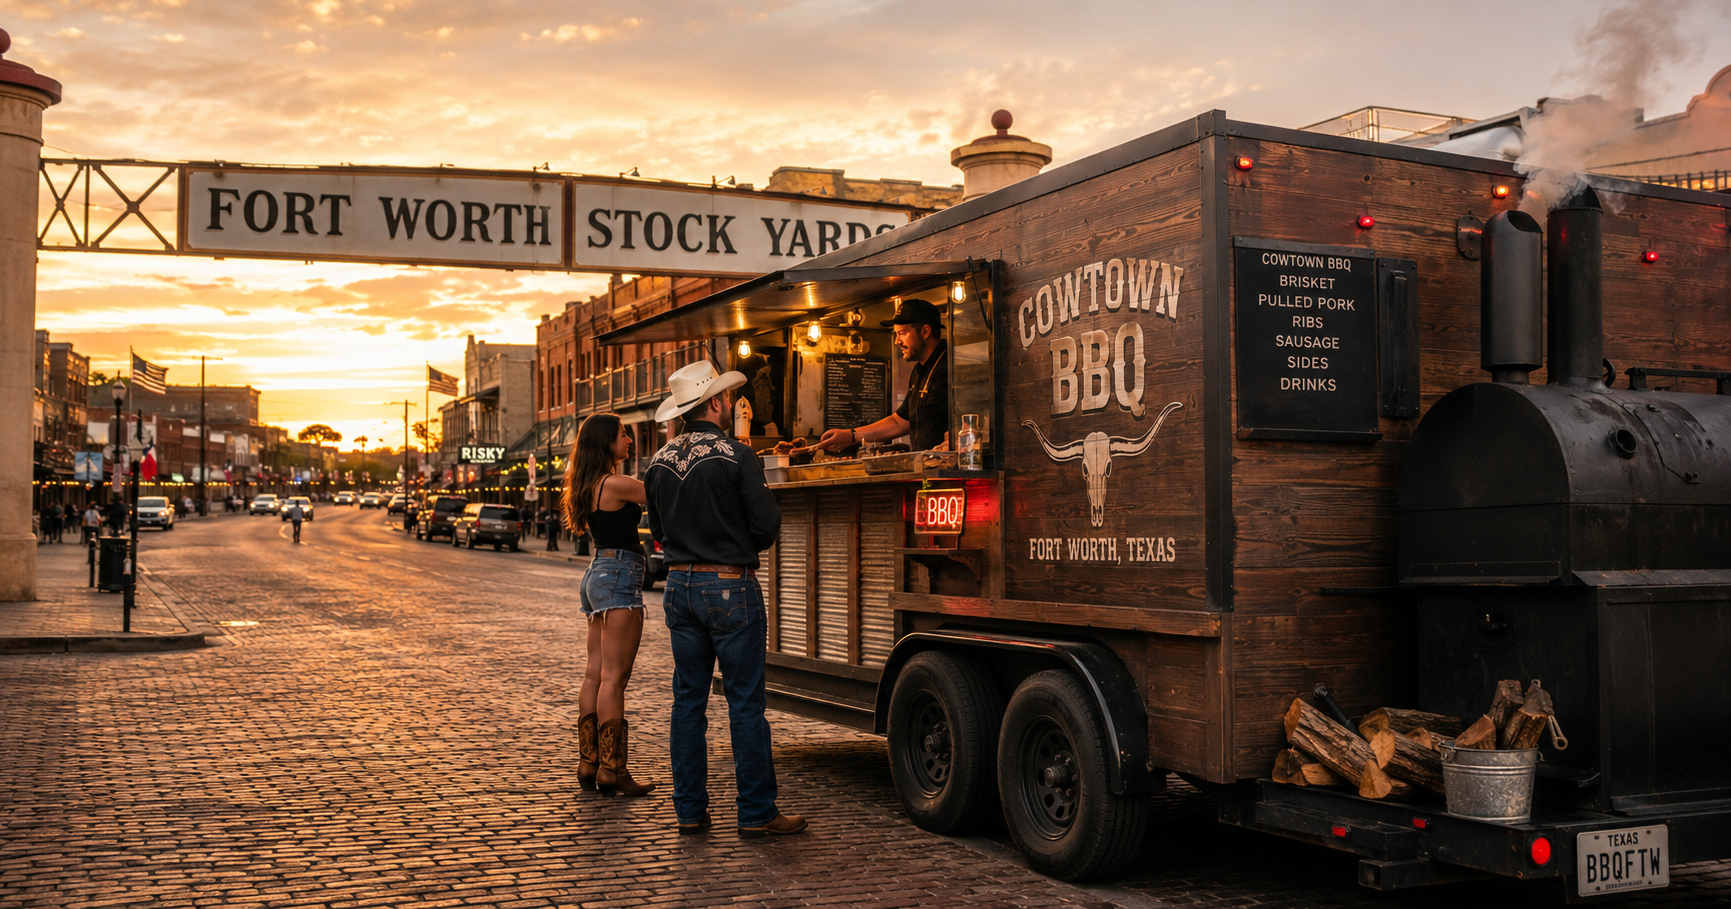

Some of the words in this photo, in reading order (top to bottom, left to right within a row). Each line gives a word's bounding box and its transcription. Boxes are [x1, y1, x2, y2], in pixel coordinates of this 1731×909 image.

[206, 187, 352, 237] FORT
[378, 196, 552, 246] WORTH
[587, 208, 737, 255] STOCK
[760, 217, 896, 258] YARD
[1262, 252, 1324, 268] COWTOWN
[1328, 257, 1351, 272] BBQ
[1279, 275, 1335, 289] BRISKET
[1018, 257, 1184, 349] COWTOWN
[1258, 293, 1313, 308] PULLED
[1318, 297, 1355, 311] PORK
[1292, 315, 1324, 329] RIBS
[1275, 334, 1340, 349] SAUSAGE
[1050, 321, 1147, 418] BBQ
[1287, 356, 1329, 369] SIDES
[1280, 377, 1337, 392] DRINKS
[461, 446, 506, 460] RISKY
[927, 496, 958, 529] BBQ
[1029, 537, 1063, 562] FORT
[1067, 537, 1122, 565] WORTH,
[1126, 537, 1176, 563] TEXAS
[1607, 832, 1639, 847] TEXAS
[1586, 847, 1660, 884] BBQFTW
